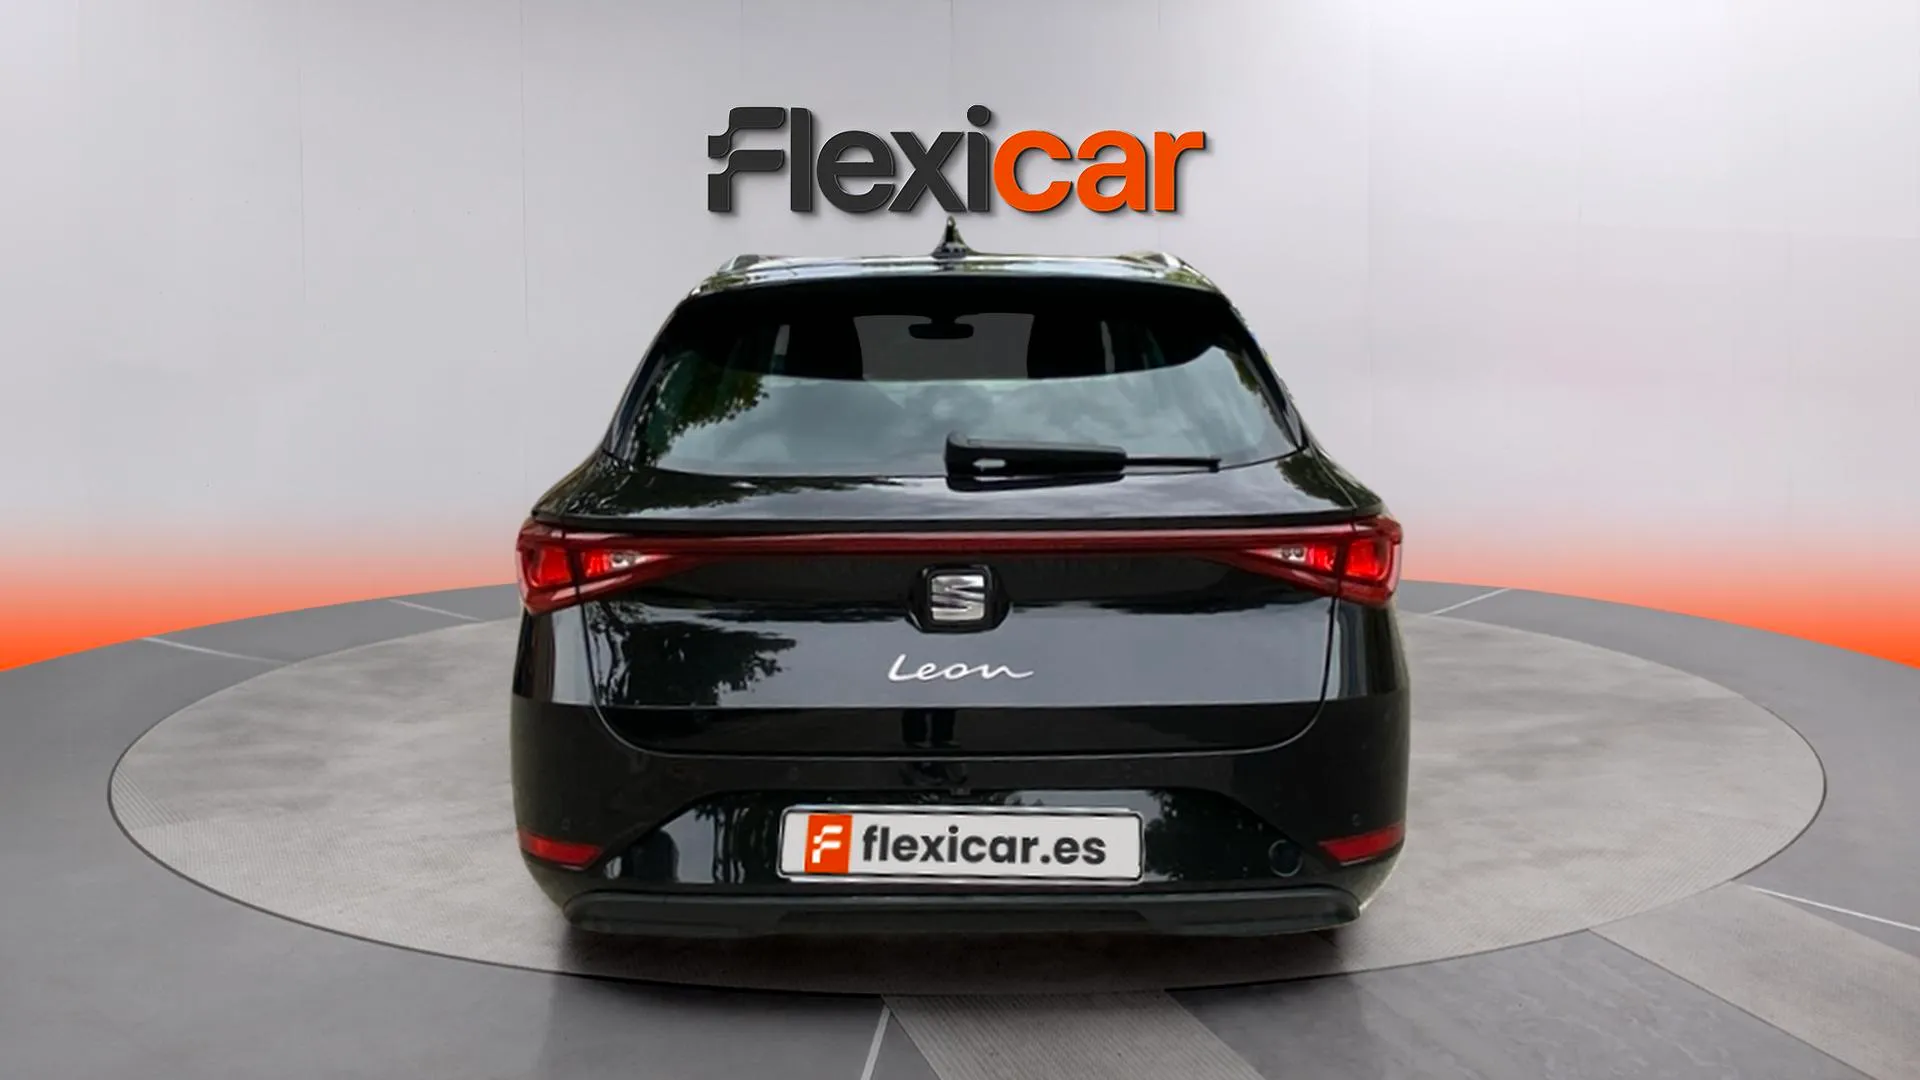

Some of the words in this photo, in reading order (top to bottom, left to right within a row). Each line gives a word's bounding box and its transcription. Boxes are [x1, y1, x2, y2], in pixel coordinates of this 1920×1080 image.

[708, 105, 1205, 212] Flexicar
[888, 653, 1034, 681] Leon
[862, 825, 1106, 864] flexicar.es
